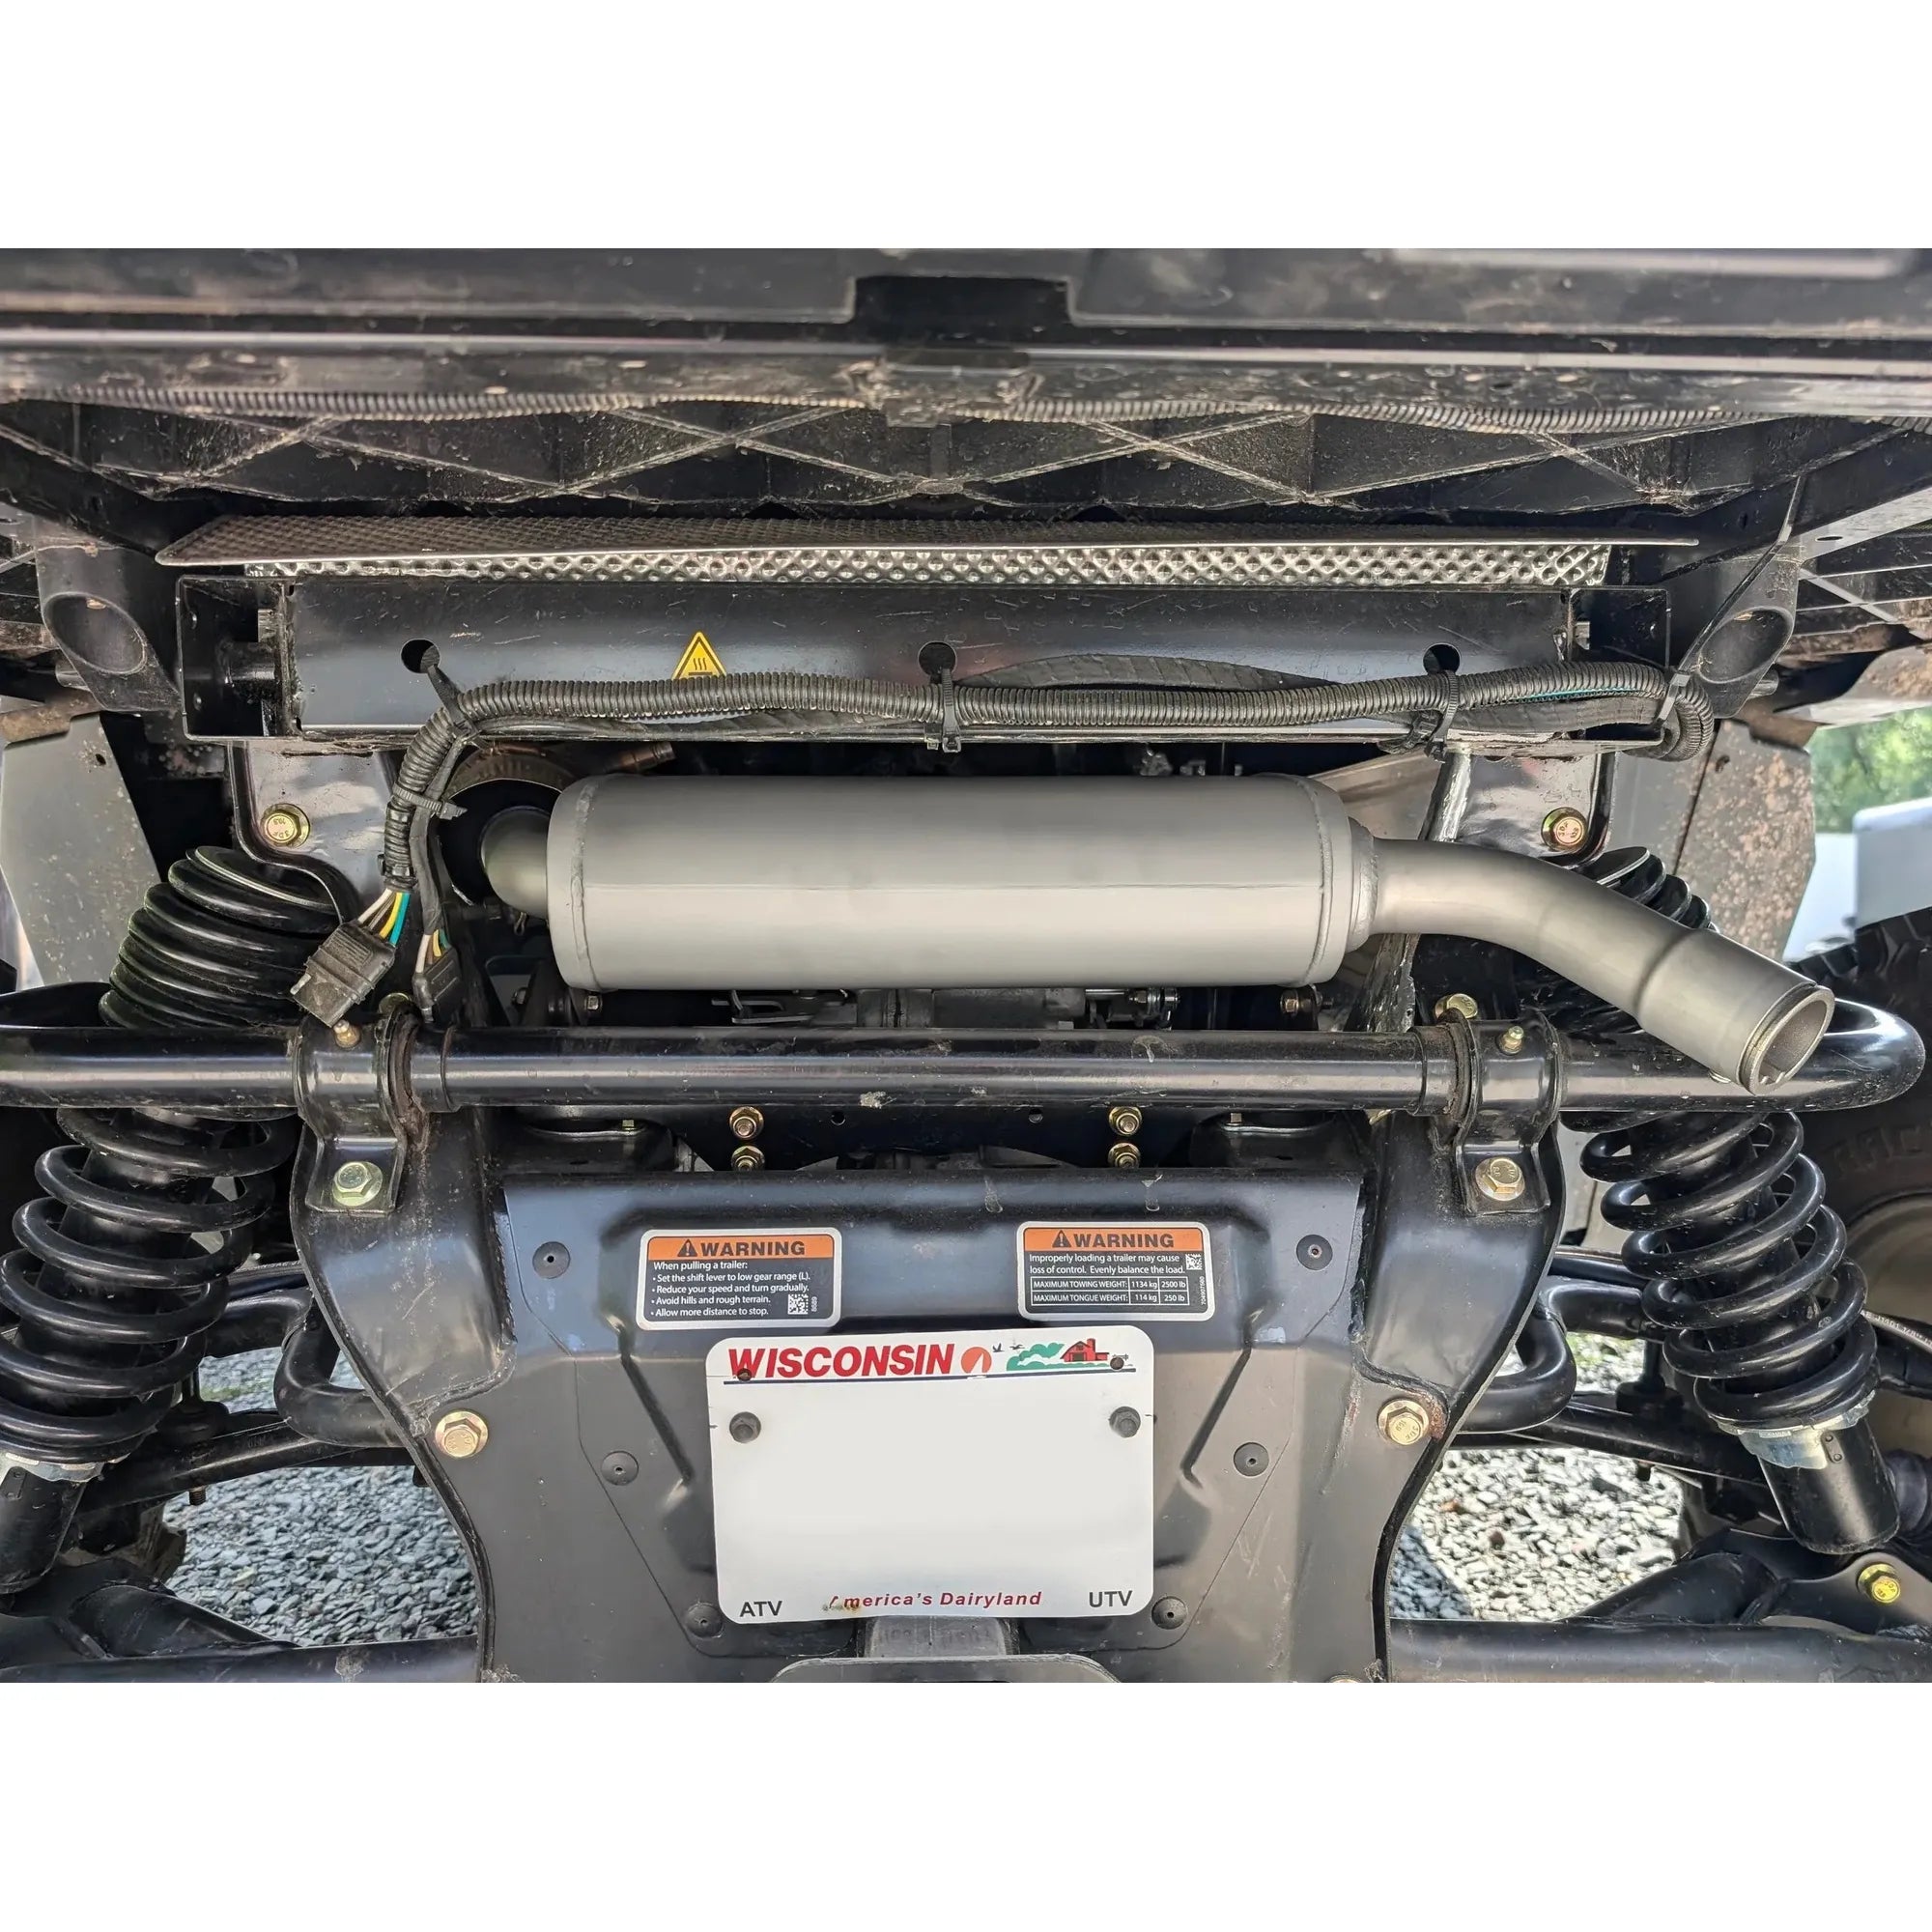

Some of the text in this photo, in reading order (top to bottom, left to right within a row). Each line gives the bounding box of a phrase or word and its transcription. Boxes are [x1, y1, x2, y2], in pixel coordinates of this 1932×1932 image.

[1073, 1233, 1175, 1248] WARNING
[700, 1240, 806, 1257] WARNING
[1029, 1254, 1074, 1264] Improperly
[1074, 1253, 1106, 1264] loading
[1113, 1253, 1137, 1263] trailer
[1138, 1255, 1155, 1264] may
[653, 1261, 679, 1270] When
[680, 1261, 712, 1272] pulling
[720, 1260, 749, 1269] trailer:
[1030, 1264, 1186, 1275] loss of control. Evenly balance the load.
[657, 1274, 670, 1283] Set
[671, 1273, 686, 1282] the
[687, 1273, 705, 1282] shift
[706, 1272, 726, 1282] lever
[737, 1272, 753, 1281] low
[753, 1273, 773, 1283] gear
[773, 1272, 798, 1282] range
[798, 1271, 810, 1281] (L).
[657, 1283, 810, 1295] Reduce your speed and turn gradually.
[1033, 1280, 1186, 1290] MAXIMUM TOWING WEIGHT: 1134 kg 2500 lb
[656, 1294, 771, 1306] Avoid hills and rough terrain.
[1033, 1293, 1185, 1303] MAXIMUM TONGUE WEIGHT: 114 kg 250 lb
[655, 1306, 769, 1317] Allow more distance to stop.
[727, 1344, 954, 1378] WISCONSIN
[940, 1591, 1042, 1609] Dairyland
[1089, 1590, 1132, 1608] UTV
[739, 1600, 782, 1618] ATV
